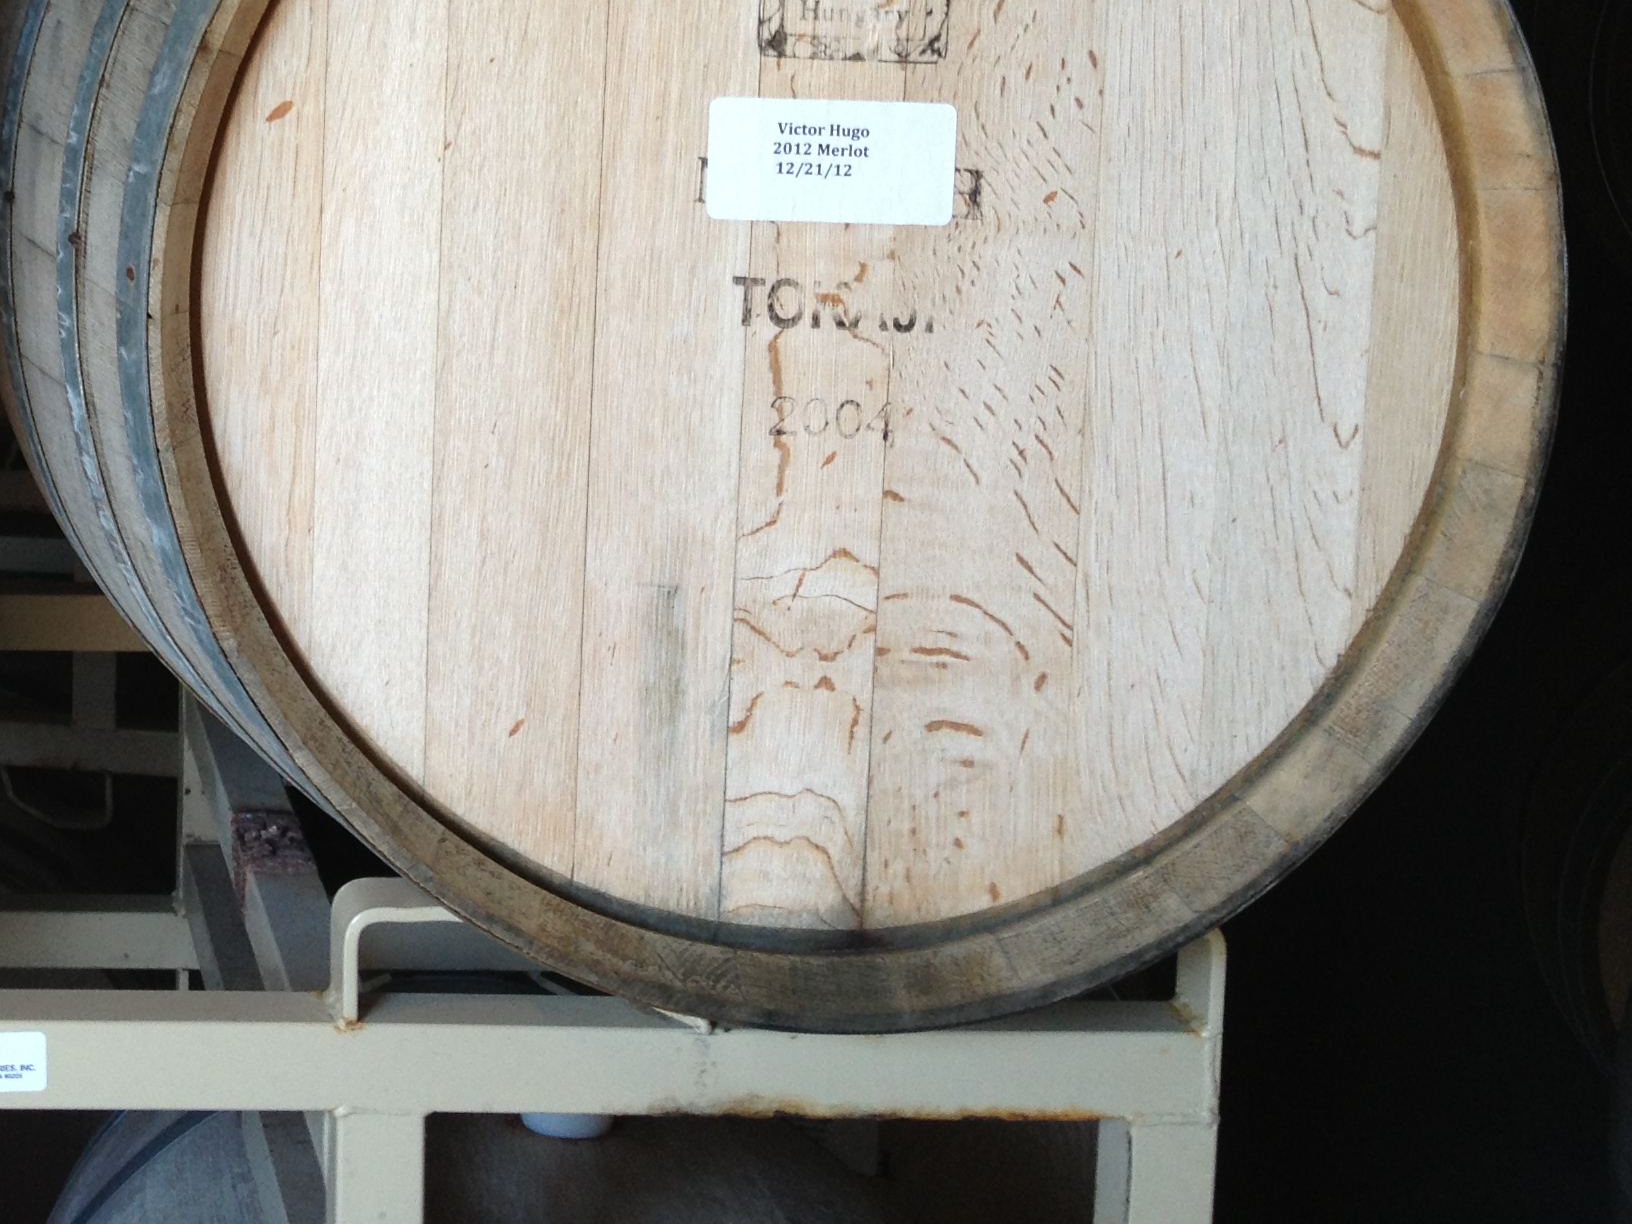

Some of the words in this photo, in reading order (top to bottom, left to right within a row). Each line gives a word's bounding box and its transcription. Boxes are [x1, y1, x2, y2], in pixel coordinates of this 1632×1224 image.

[778, 122, 825, 137] Victor
[829, 124, 870, 139] Hugo
[773, 142, 812, 156] 2012
[817, 143, 869, 158] Merlot
[776, 162, 852, 178] 12/21/12
